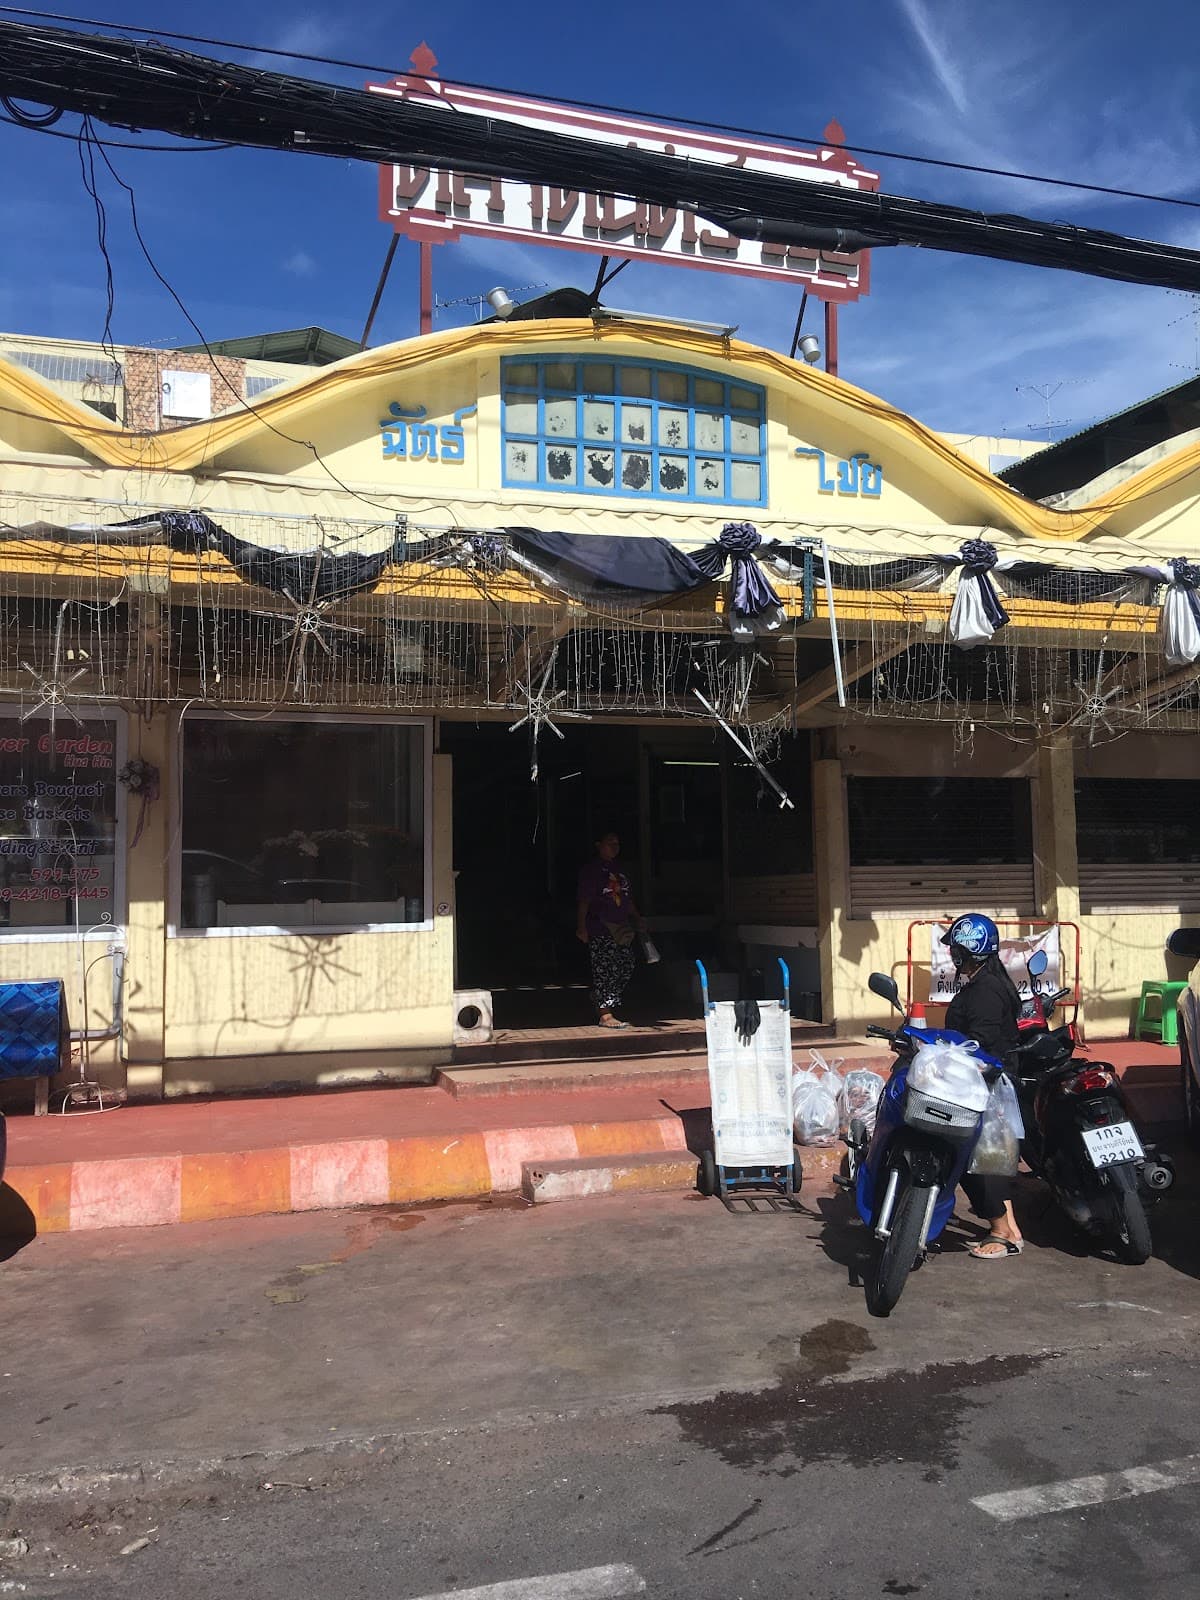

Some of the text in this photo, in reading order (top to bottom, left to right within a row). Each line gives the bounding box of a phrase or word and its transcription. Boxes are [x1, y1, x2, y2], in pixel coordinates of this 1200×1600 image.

[795, 447, 882, 495] ไชย
[38, 733, 112, 753] Garden
[64, 754, 113, 768] Hua Hin
[34, 781, 104, 800] Bouquet
[23, 805, 91, 820] Baskets
[1096, 1126, 1123, 1140] 1กจ
[1099, 1148, 1135, 1164] 3210
